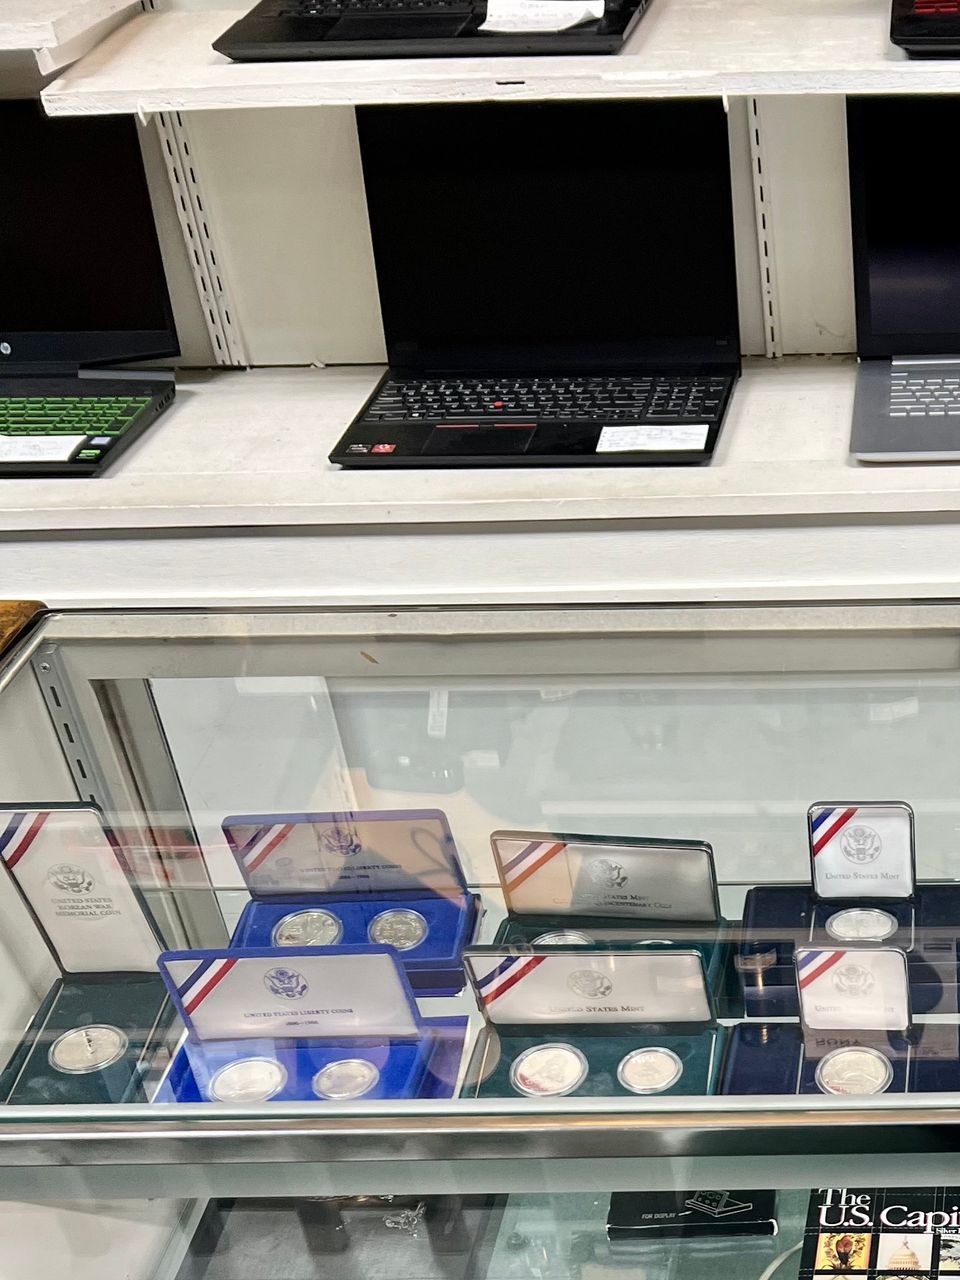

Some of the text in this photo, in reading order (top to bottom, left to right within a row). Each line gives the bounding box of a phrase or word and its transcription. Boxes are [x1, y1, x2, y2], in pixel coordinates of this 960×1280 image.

[825, 872, 852, 880] UNITED
[853, 872, 879, 880] STATES
[818, 1188, 871, 1206] The
[818, 1206, 874, 1228] U.S.
